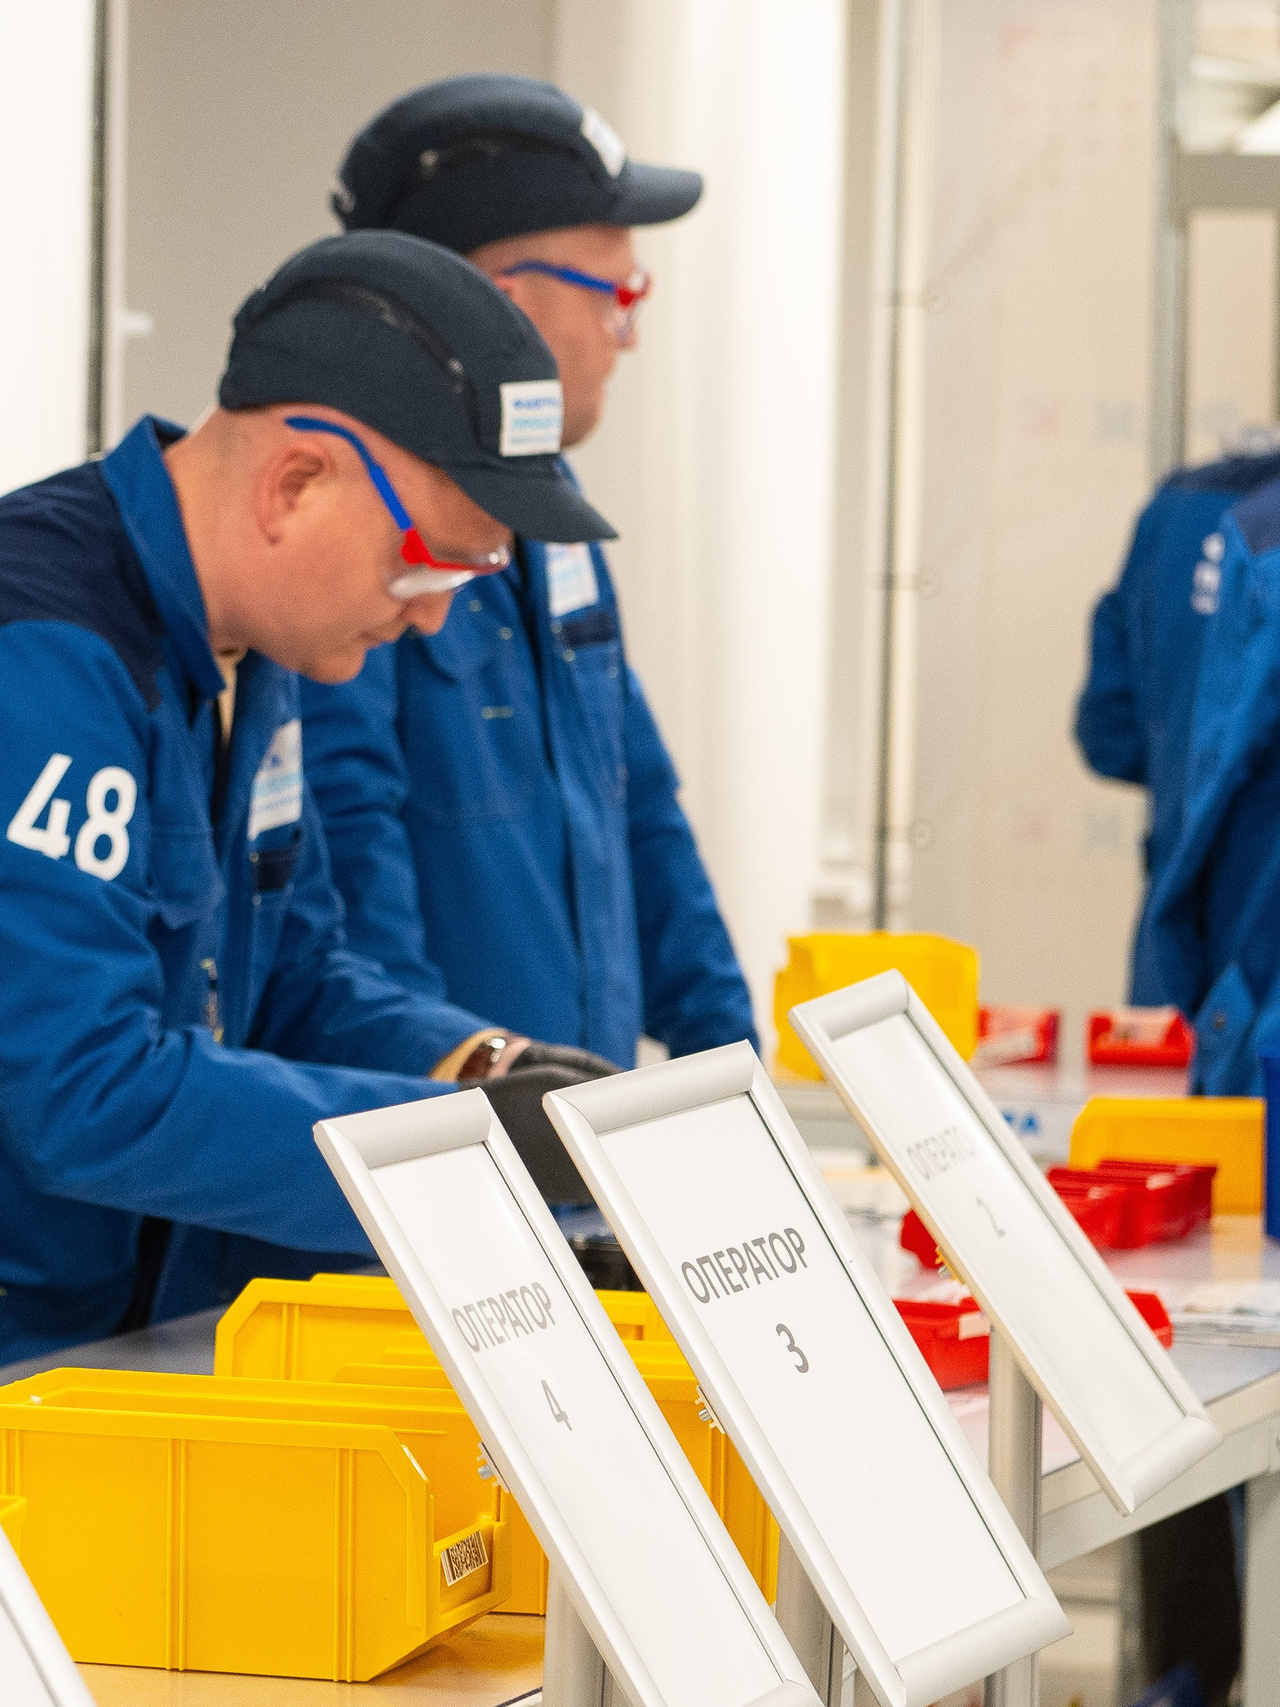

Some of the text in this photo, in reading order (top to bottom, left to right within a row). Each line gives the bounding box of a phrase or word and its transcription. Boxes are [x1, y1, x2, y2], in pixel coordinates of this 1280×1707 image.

[6, 752, 138, 882] 48
[906, 1123, 977, 1182] ОПЕРАТО
[681, 1227, 808, 1304] ОПЕРАТОР
[451, 1281, 556, 1353] ОПЕРАТОР
[775, 1323, 810, 1374] 3
[540, 1379, 573, 1432] 4
